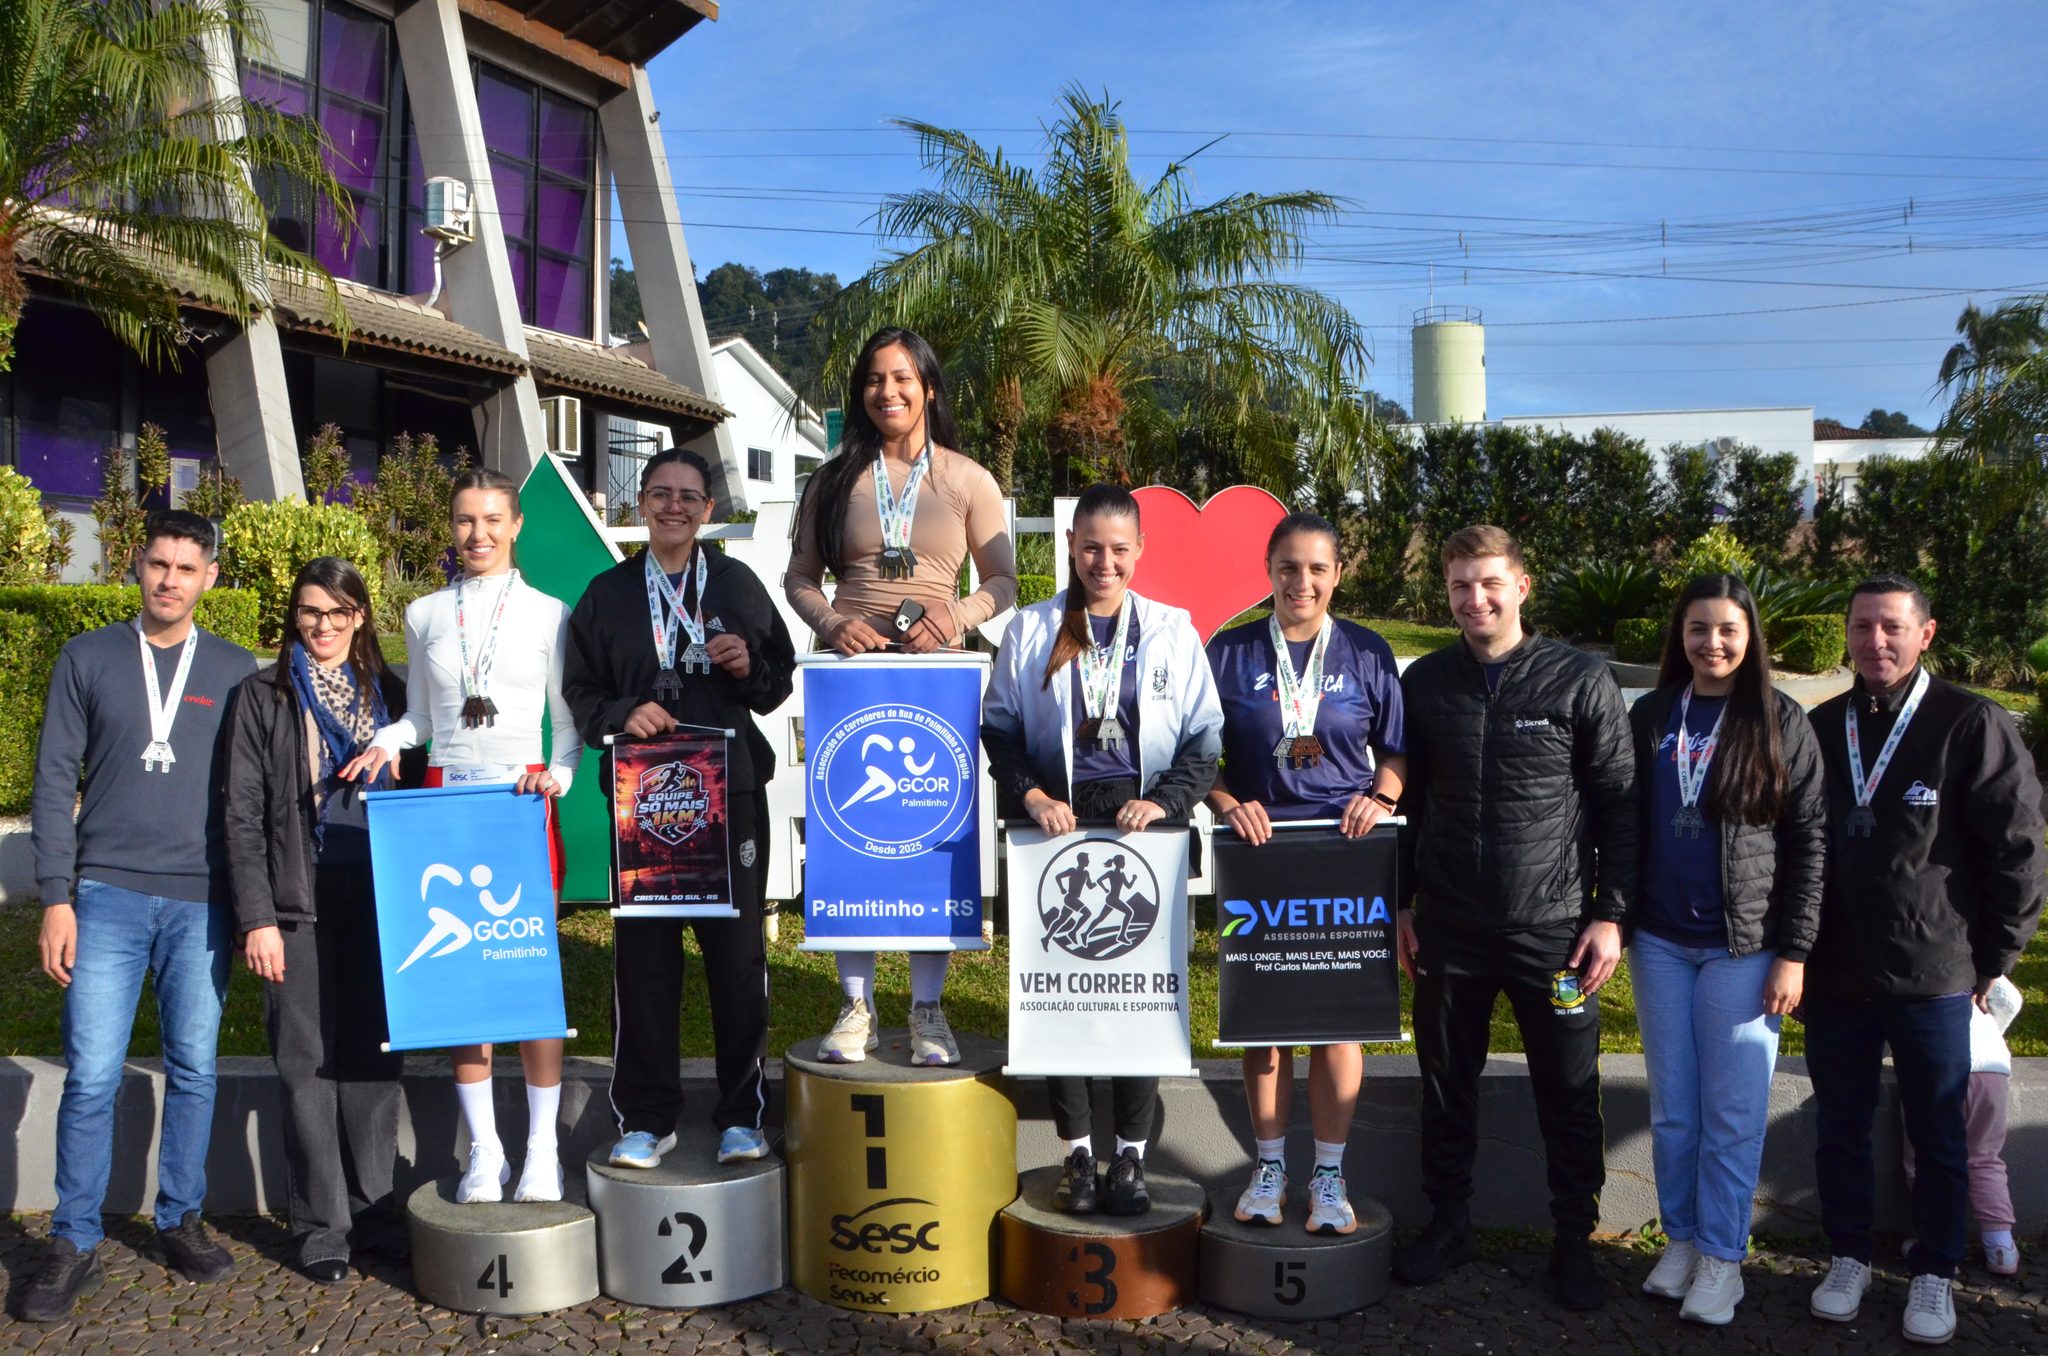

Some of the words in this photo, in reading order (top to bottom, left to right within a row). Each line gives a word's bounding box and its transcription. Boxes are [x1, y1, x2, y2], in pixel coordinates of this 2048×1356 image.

[816, 738, 838, 781] Associação
[835, 729, 846, 740] de
[843, 710, 886, 733] Corredores
[887, 709, 897, 718] de
[898, 709, 914, 720] Rua
[914, 713, 925, 723] de
[924, 717, 958, 748] Palmitinho
[957, 752, 971, 780] Região
[897, 777, 949, 793] GCOR
[647, 791, 693, 802] EQUIPE
[902, 798, 948, 808] Palmitinho
[638, 800, 661, 814] SÓ
[664, 799, 705, 811] MAIS
[652, 809, 696, 826] 1KM
[864, 840, 897, 856] Desde
[898, 840, 923, 854] 2025
[633, 894, 670, 902] CRISTAL
[812, 899, 925, 918] Palmitinho
[944, 899, 975, 918] RS
[1260, 896, 1392, 927] VETRIA
[473, 917, 546, 942] GCOR
[1263, 931, 1327, 942] ASSESSORIA
[1330, 929, 1386, 940] ESPORTIVA
[482, 945, 548, 961] Palmitinho
[1225, 953, 1249, 963] MAIS
[1250, 952, 1284, 963] LONGE,
[1286, 952, 1309, 962] MAIS
[1310, 951, 1336, 962] LEVE,
[1338, 950, 1361, 960] MAIS
[1362, 947, 1391, 959] VOCÊ!
[1255, 962, 1273, 972] Prof
[1274, 961, 1301, 972] Carlos
[1302, 961, 1330, 971] Manfio
[1331, 960, 1362, 971] Martins
[1020, 972, 1061, 994] VEM
[1067, 972, 1147, 994] CORRER
[1152, 972, 1180, 994] RB
[1019, 1000, 1075, 1014] ASSOCIAÇÃO
[1077, 1001, 1121, 1012] CULTURAL
[1123, 1001, 1128, 1012] E
[1130, 1001, 1179, 1012] ESPORTIVA
[851, 1093, 887, 1190] 1
[658, 1212, 713, 1284] 2
[477, 1254, 514, 1298] 4
[1066, 1242, 1118, 1315] 3
[1274, 1261, 1307, 1306] 5
